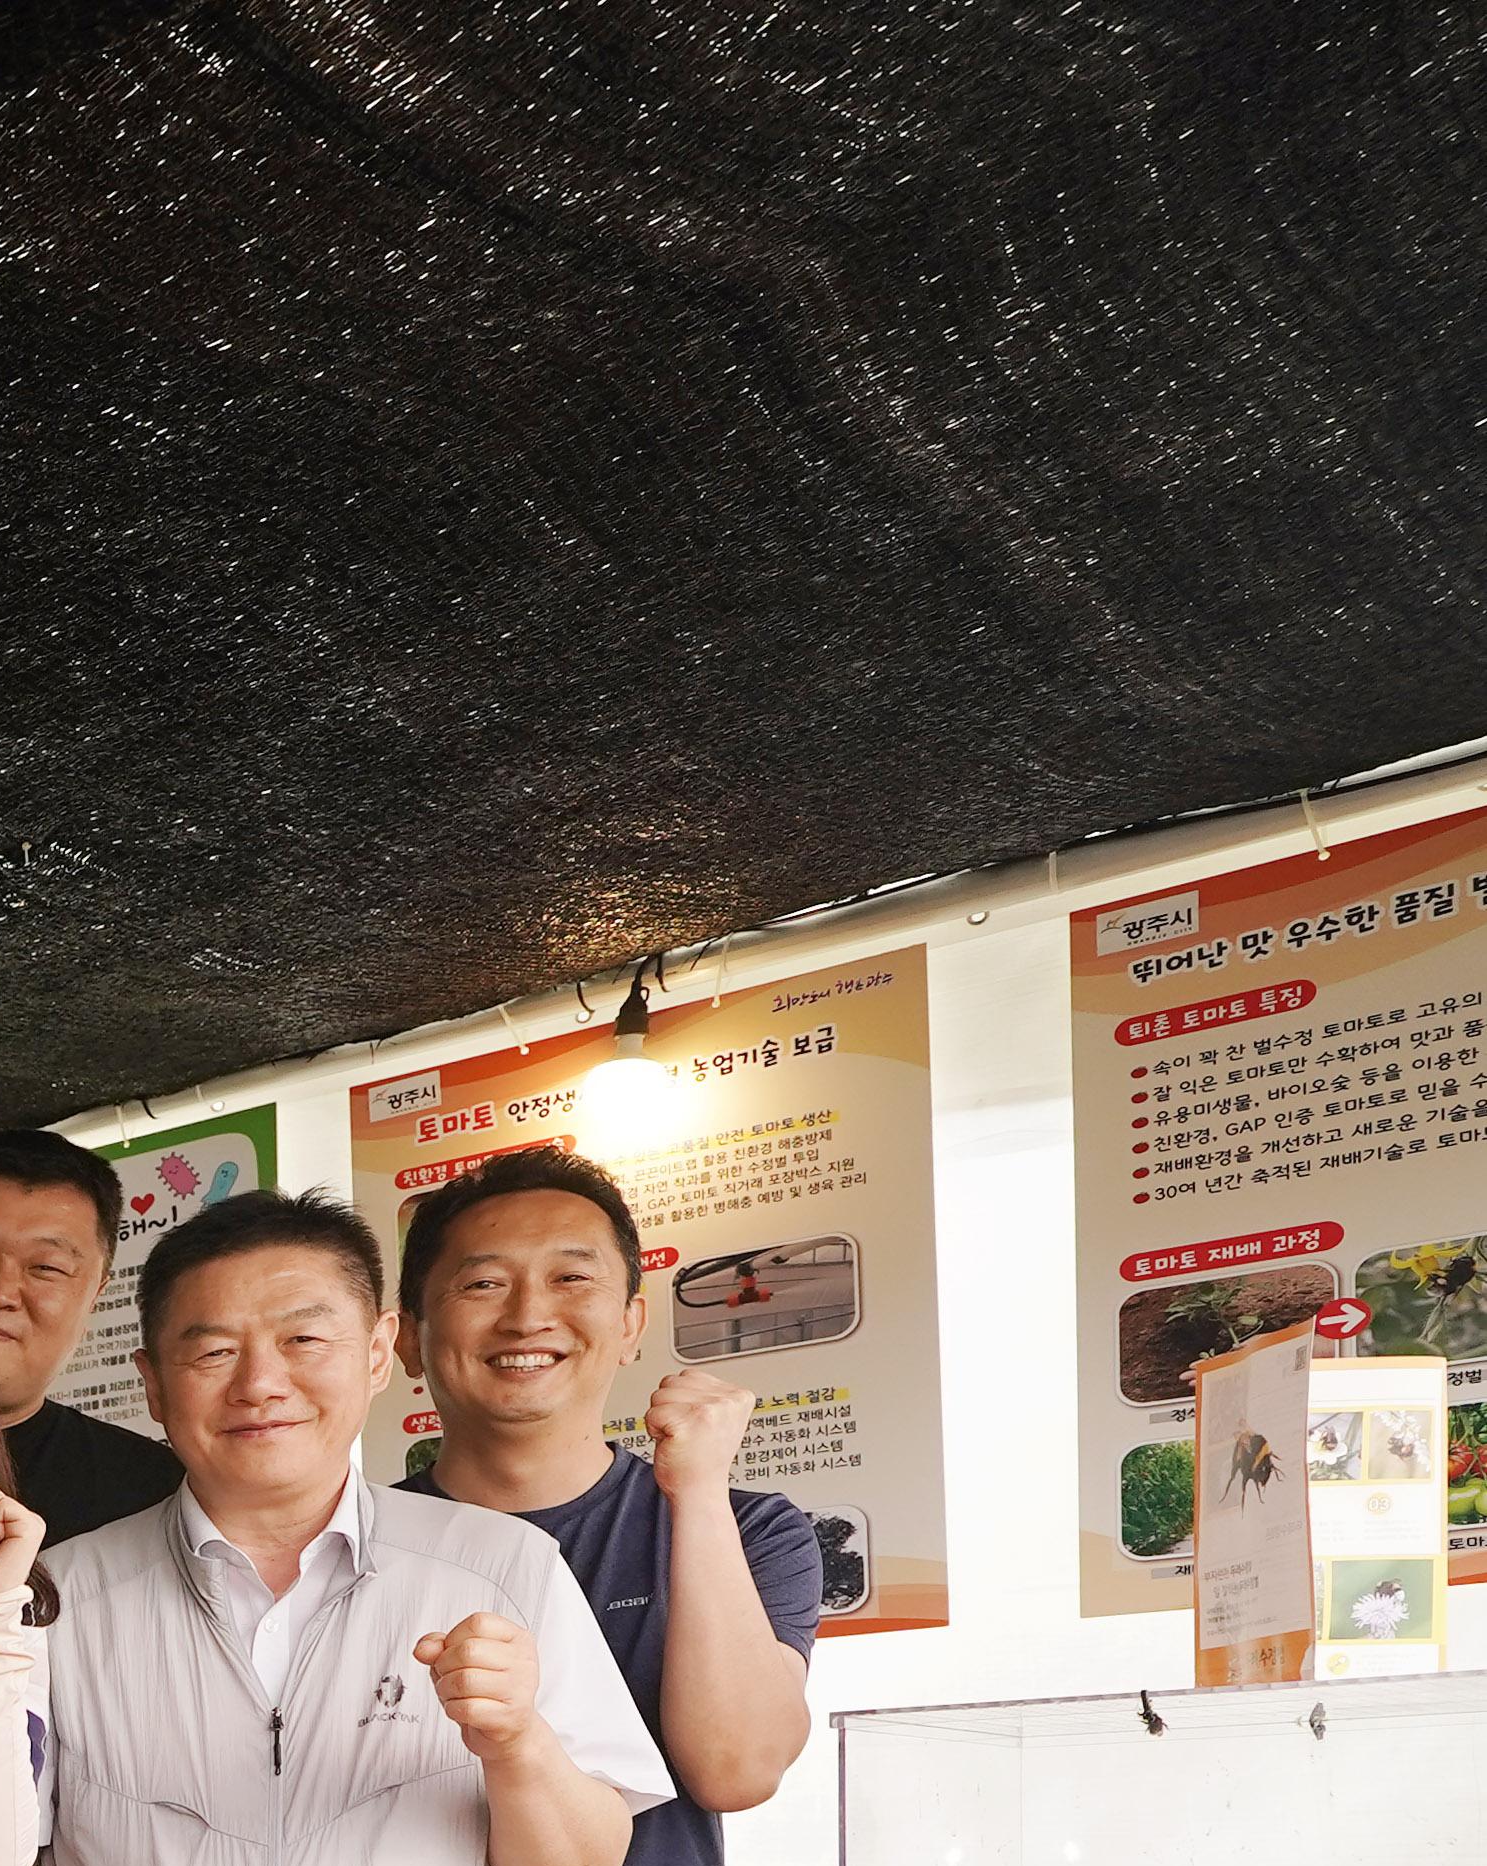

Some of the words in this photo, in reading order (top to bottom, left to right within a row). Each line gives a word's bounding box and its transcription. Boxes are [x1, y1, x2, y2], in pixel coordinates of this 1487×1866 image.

[1123, 908, 1192, 939] 광주시
[1133, 942, 1227, 983] 뛰어난
[1241, 931, 1274, 960] 맛
[1287, 905, 1380, 948] 우수한
[1394, 883, 1455, 925] 품질
[1182, 999, 1247, 1029] 토마토
[1259, 986, 1303, 1013] 특징
[1152, 1055, 1191, 1076] 속이
[1198, 1049, 1219, 1065] 꽉
[1225, 1043, 1246, 1061] 찬
[1253, 1028, 1313, 1055] 벌수정
[1322, 1009, 1408, 1039] 토마토로
[1416, 992, 1483, 1019] 고유의
[417, 1104, 494, 1143] 토마토
[507, 1089, 582, 1123] 안정생
[691, 1040, 780, 1082] 농업기술
[793, 1026, 835, 1056] 보급
[1153, 1085, 1172, 1103] 잘
[1179, 1075, 1218, 1095] 익은
[1226, 1056, 1308, 1085] 토마토만
[1315, 1036, 1402, 1067] 수확하여
[1410, 1025, 1455, 1050] 맛과
[388, 1084, 437, 1110] 광주시
[1153, 1093, 1260, 1127] 유용미생물,
[1359, 1063, 1403, 1086] 등을
[1411, 1047, 1480, 1071] 이용한
[716, 1128, 745, 1145] 안전
[751, 1117, 795, 1137] 토마토
[801, 1109, 833, 1127] 생산
[1153, 1127, 1218, 1153] 친환경,
[1226, 1117, 1267, 1137] GAP
[1274, 1107, 1315, 1129] 인증
[1323, 1089, 1409, 1118] 토마토로
[1418, 1078, 1461, 1101] 믿을
[1153, 1145, 1254, 1175] 재배환경을
[1261, 1128, 1344, 1155] 개선하고
[1351, 1113, 1418, 1137] 새로운
[1426, 1099, 1487, 1123] 기술을
[703, 1150, 727, 1168] 활용
[734, 1141, 773, 1161] 친환경
[777, 1129, 834, 1151] 해충방제
[1154, 1182, 1196, 1201] 30여
[1205, 1173, 1243, 1194] 년간
[1250, 1159, 1311, 1184] 축적된
[1320, 1138, 1428, 1170] 재배기술로
[1436, 1128, 1487, 1149] 토마
[402, 1166, 448, 1187] 친환경
[644, 1180, 668, 1195] 자연
[717, 1164, 743, 1180] 위한
[748, 1155, 788, 1175] 수정벌
[793, 1148, 820, 1164] 투입
[647, 1195, 676, 1210] GAP
[681, 1184, 718, 1205] 토마토
[723, 1176, 763, 1195] 직거래
[768, 1166, 823, 1187] 포장박스
[828, 1156, 856, 1174] 지원
[671, 1204, 709, 1223] 활용한
[713, 1194, 753, 1214] 병해충
[757, 1186, 784, 1204] 예방
[789, 1184, 803, 1201] 및
[807, 1178, 835, 1197] 생육
[840, 1171, 868, 1189] 관리
[1134, 1250, 1199, 1277] 토마토
[1207, 1239, 1263, 1264] 재배
[1272, 1229, 1322, 1254] 과정
[772, 1393, 802, 1408] 노력
[806, 1386, 837, 1405] 절감
[796, 1404, 852, 1424] 재배시설
[744, 1446, 798, 1466] 환경제어
[802, 1439, 845, 1457] 시스템
[770, 1427, 811, 1446] 자동화
[815, 1419, 858, 1438] 시스템
[775, 1459, 817, 1477] 자동화
[820, 1452, 862, 1470] 시스템
[1449, 1536, 1487, 1550] 토마
